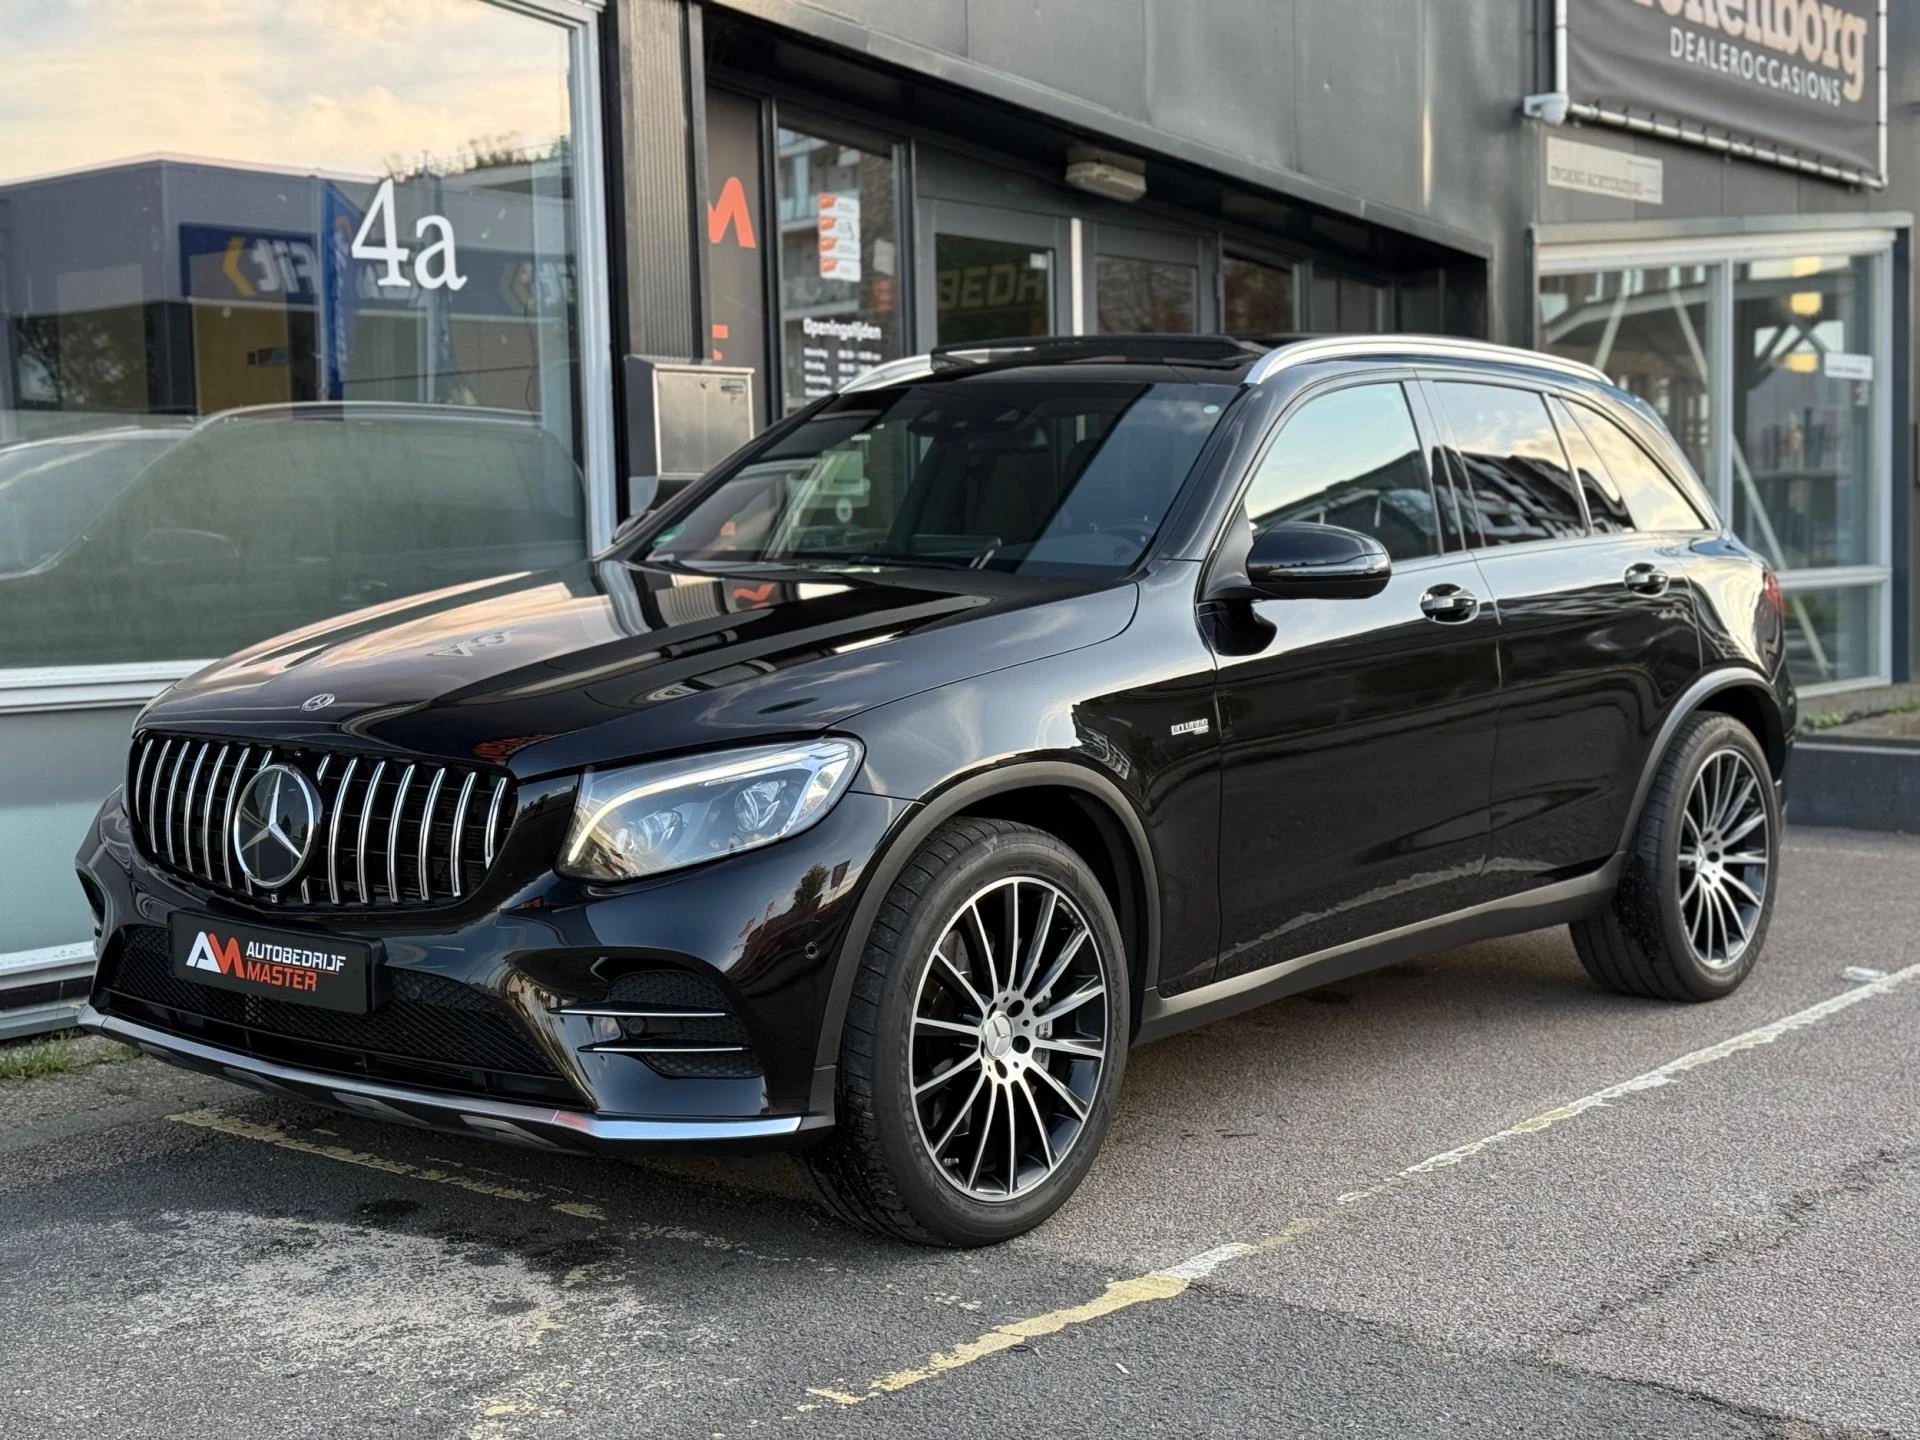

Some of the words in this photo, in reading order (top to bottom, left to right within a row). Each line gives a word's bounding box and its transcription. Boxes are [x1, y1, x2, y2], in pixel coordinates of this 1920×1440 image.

[1669, 26, 1841, 106] DEALEROCCASIONS
[351, 177, 467, 292] 4a
[246, 941, 346, 972] AUTOBEDRIJF
[247, 961, 317, 992] MASTER
